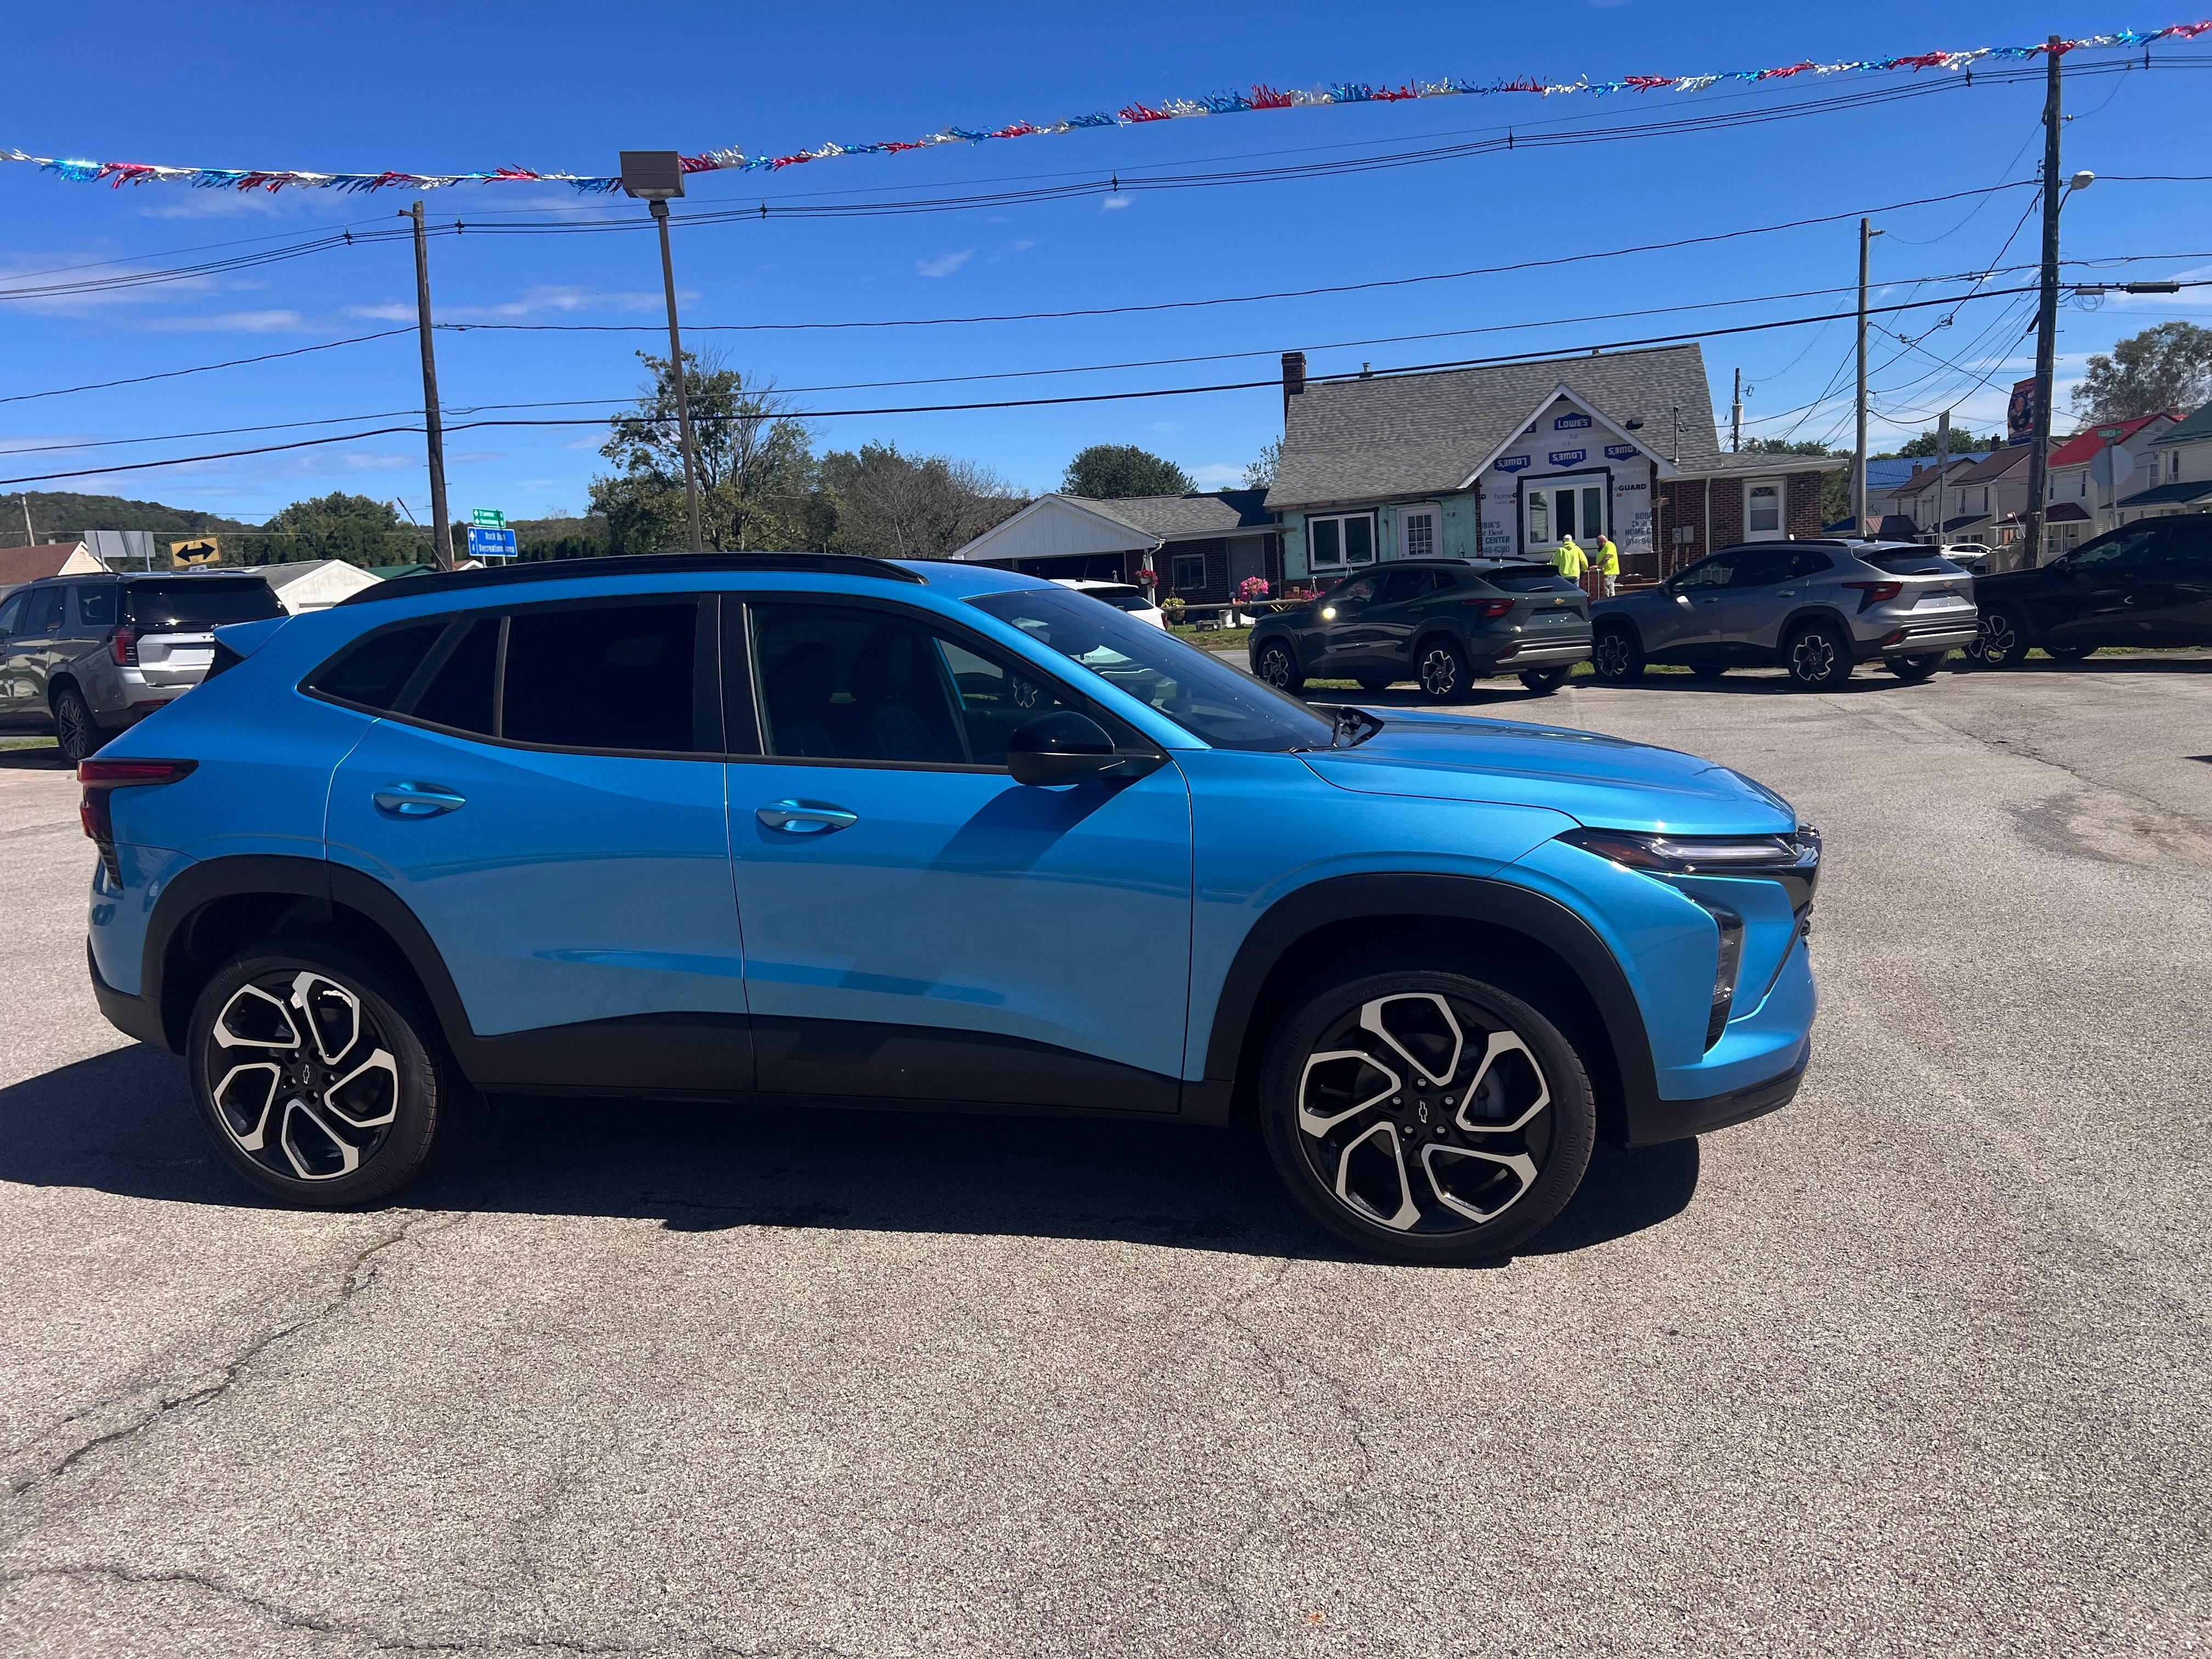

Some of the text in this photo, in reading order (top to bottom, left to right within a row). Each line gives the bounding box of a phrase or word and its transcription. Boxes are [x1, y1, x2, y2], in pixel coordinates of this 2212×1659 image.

[1558, 418, 1588, 428] LOWE'S
[1553, 450, 1583, 462] LOWE'S
[1497, 457, 1527, 468] LOWE'S
[1486, 535, 1510, 544] CENTER
